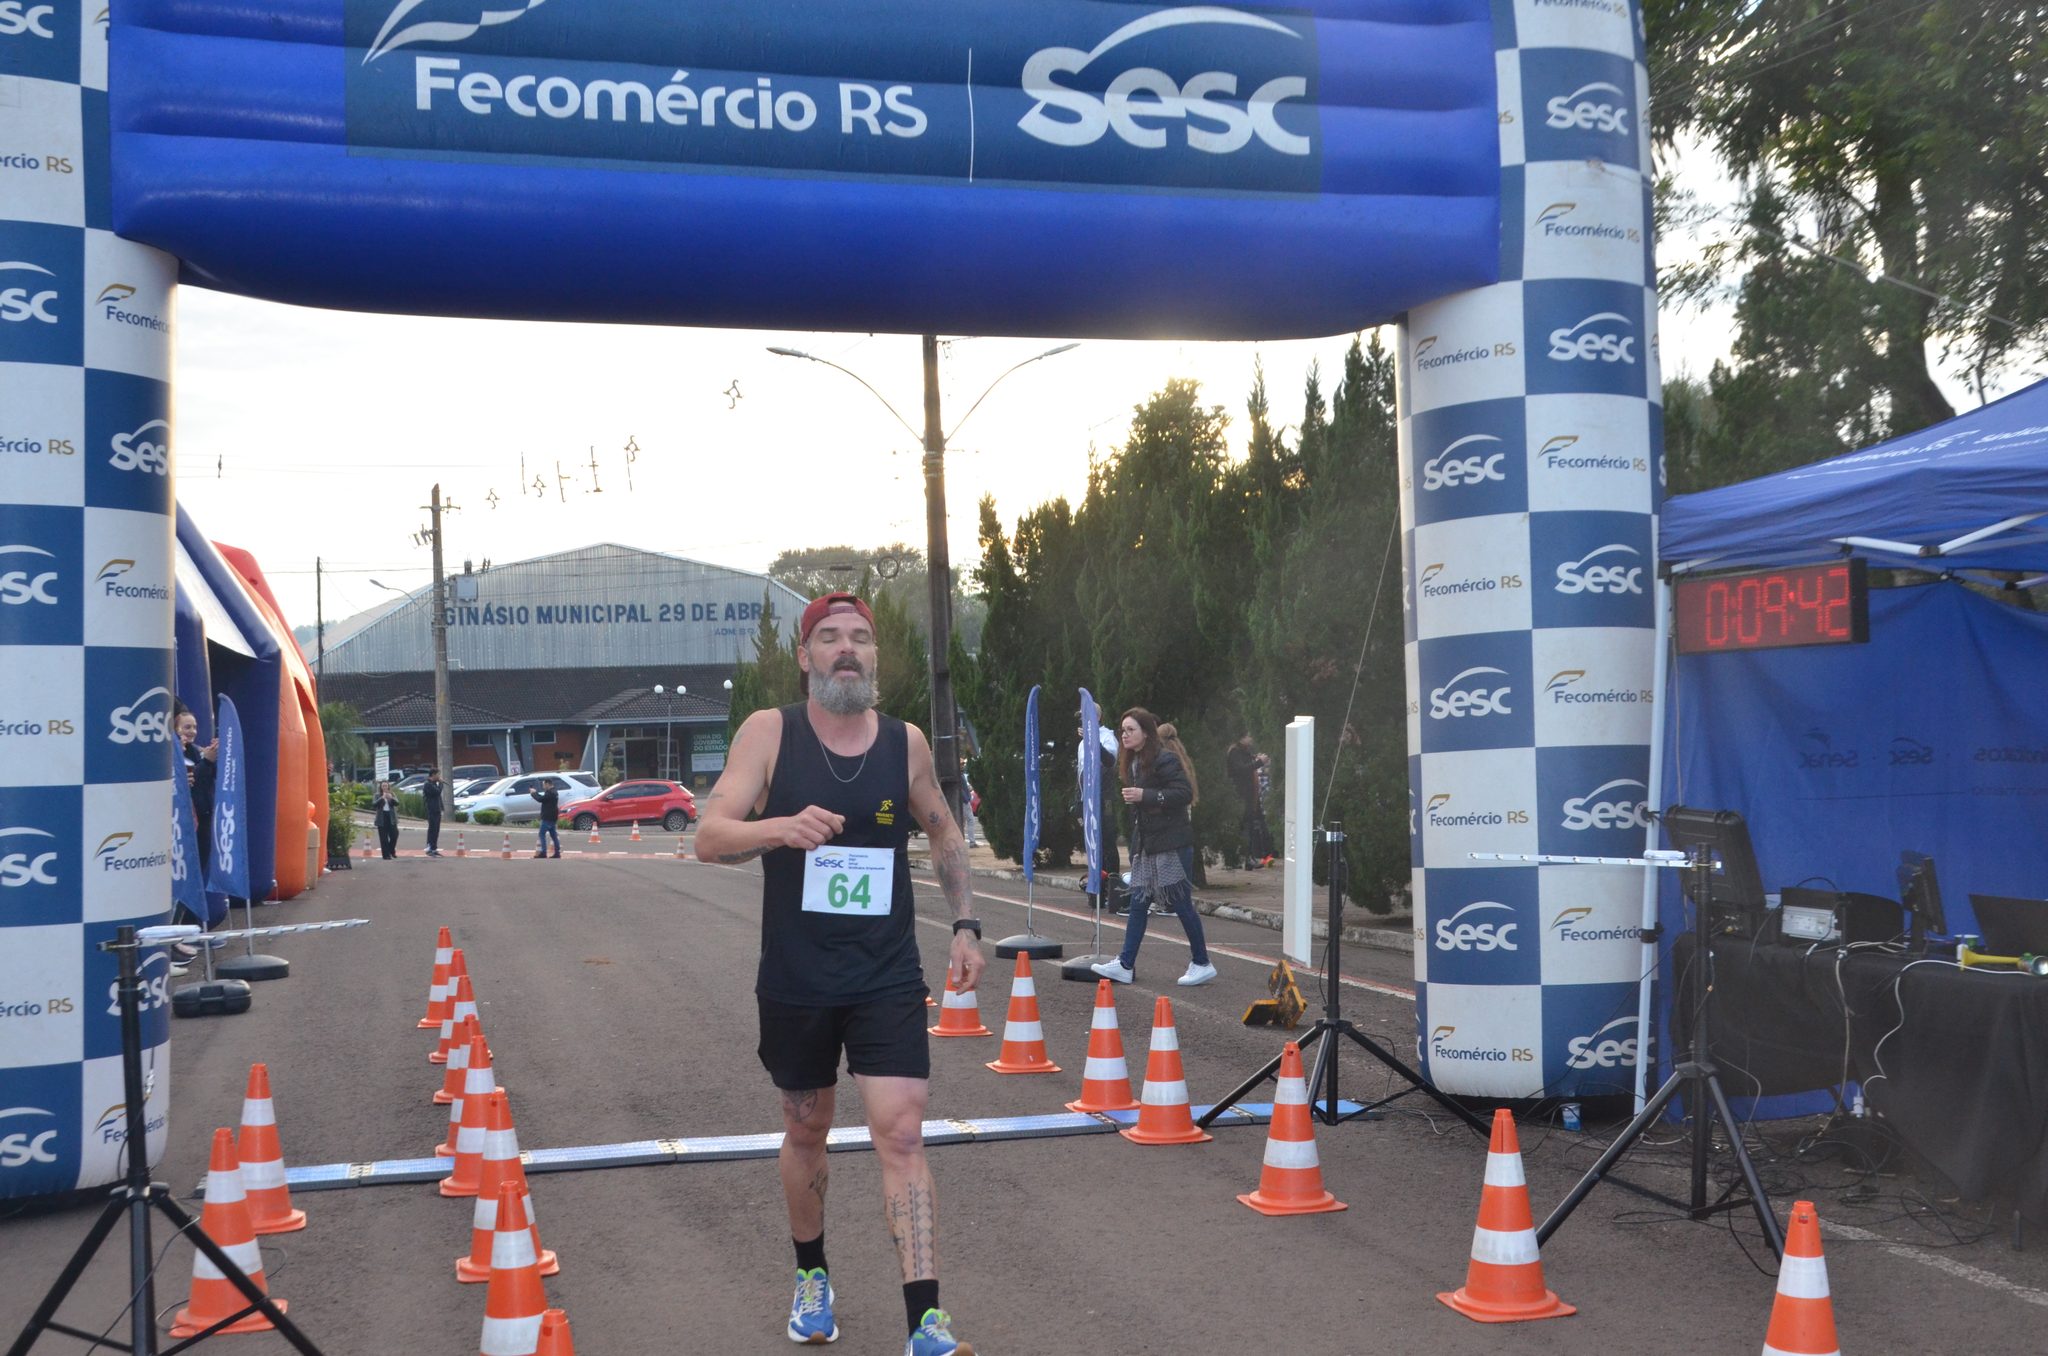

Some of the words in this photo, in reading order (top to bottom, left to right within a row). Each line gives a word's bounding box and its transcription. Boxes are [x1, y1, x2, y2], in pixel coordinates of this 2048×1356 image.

[416, 56, 817, 131] Fecomércio
[839, 83, 928, 138] RS
[1017, 47, 1310, 155] Sesc
[1546, 96, 1629, 136] Sesc
[0, 153, 39, 169] rcio
[46, 156, 74, 174] RS
[1545, 222, 1625, 240] Fecomércio
[0, 288, 58, 323] sc
[1417, 346, 1489, 371] Fecomércio
[1494, 342, 1516, 358] RS
[1548, 328, 1635, 364] Sesc
[48, 439, 75, 455] RS
[1548, 454, 1630, 471] Fecomércio
[1633, 458, 1648, 472] RS
[1423, 452, 1505, 491] Sesc
[0, 571, 58, 605] sc
[1424, 577, 1496, 597] Fecomércio
[1500, 575, 1523, 588] RS
[1554, 561, 1643, 594] Sesc
[444, 602, 529, 626] GINÁSIO
[537, 604, 652, 624] MUNICIPAL
[659, 603, 685, 622] 29
[692, 603, 717, 622] DE
[724, 601, 782, 621] ABRL
[1705, 567, 1850, 647] 0:09:42
[1429, 687, 1511, 720] Sesc
[1554, 688, 1638, 704] Fecomércio
[1640, 690, 1654, 703] RS
[48, 720, 74, 735] RS
[1430, 811, 1502, 827] Fecomércio
[1507, 810, 1529, 823] RS
[219, 802, 236, 874] Sesc
[0, 852, 57, 887] sc
[814, 857, 844, 868] Sesc
[827, 873, 871, 910] 64
[1435, 918, 1518, 951] Sesc
[48, 998, 73, 1014] RS
[1435, 1044, 1507, 1062] Fecomércio
[1512, 1048, 1533, 1062] RS
[0, 1130, 57, 1167] sc
